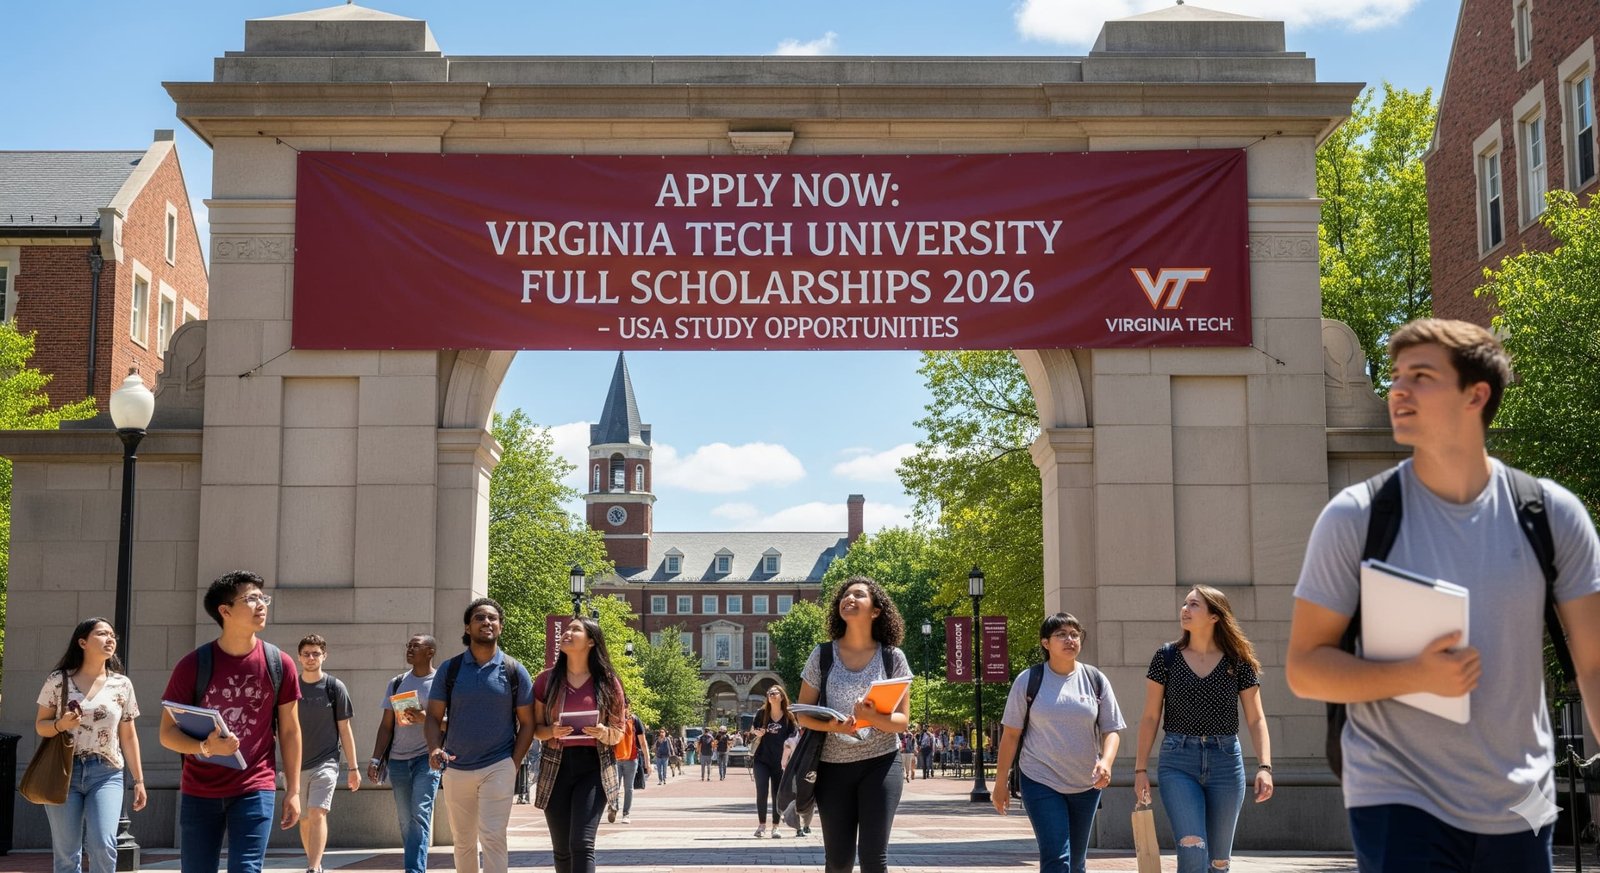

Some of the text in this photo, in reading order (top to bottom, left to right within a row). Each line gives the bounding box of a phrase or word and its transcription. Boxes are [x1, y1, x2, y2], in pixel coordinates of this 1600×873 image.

[655, 173, 900, 208] APPLY NOW:
[486, 221, 1063, 256] VIRGINIA TECH UNIVERSITY
[521, 269, 1034, 305] FULL SCHOLARSHIPS 2026
[1131, 267, 1211, 310] VT
[619, 317, 670, 340] USA
[675, 317, 758, 340] STUDY
[765, 316, 959, 339] OPPORTUNITIES
[1105, 317, 1232, 333] VIRGINIA TECH
